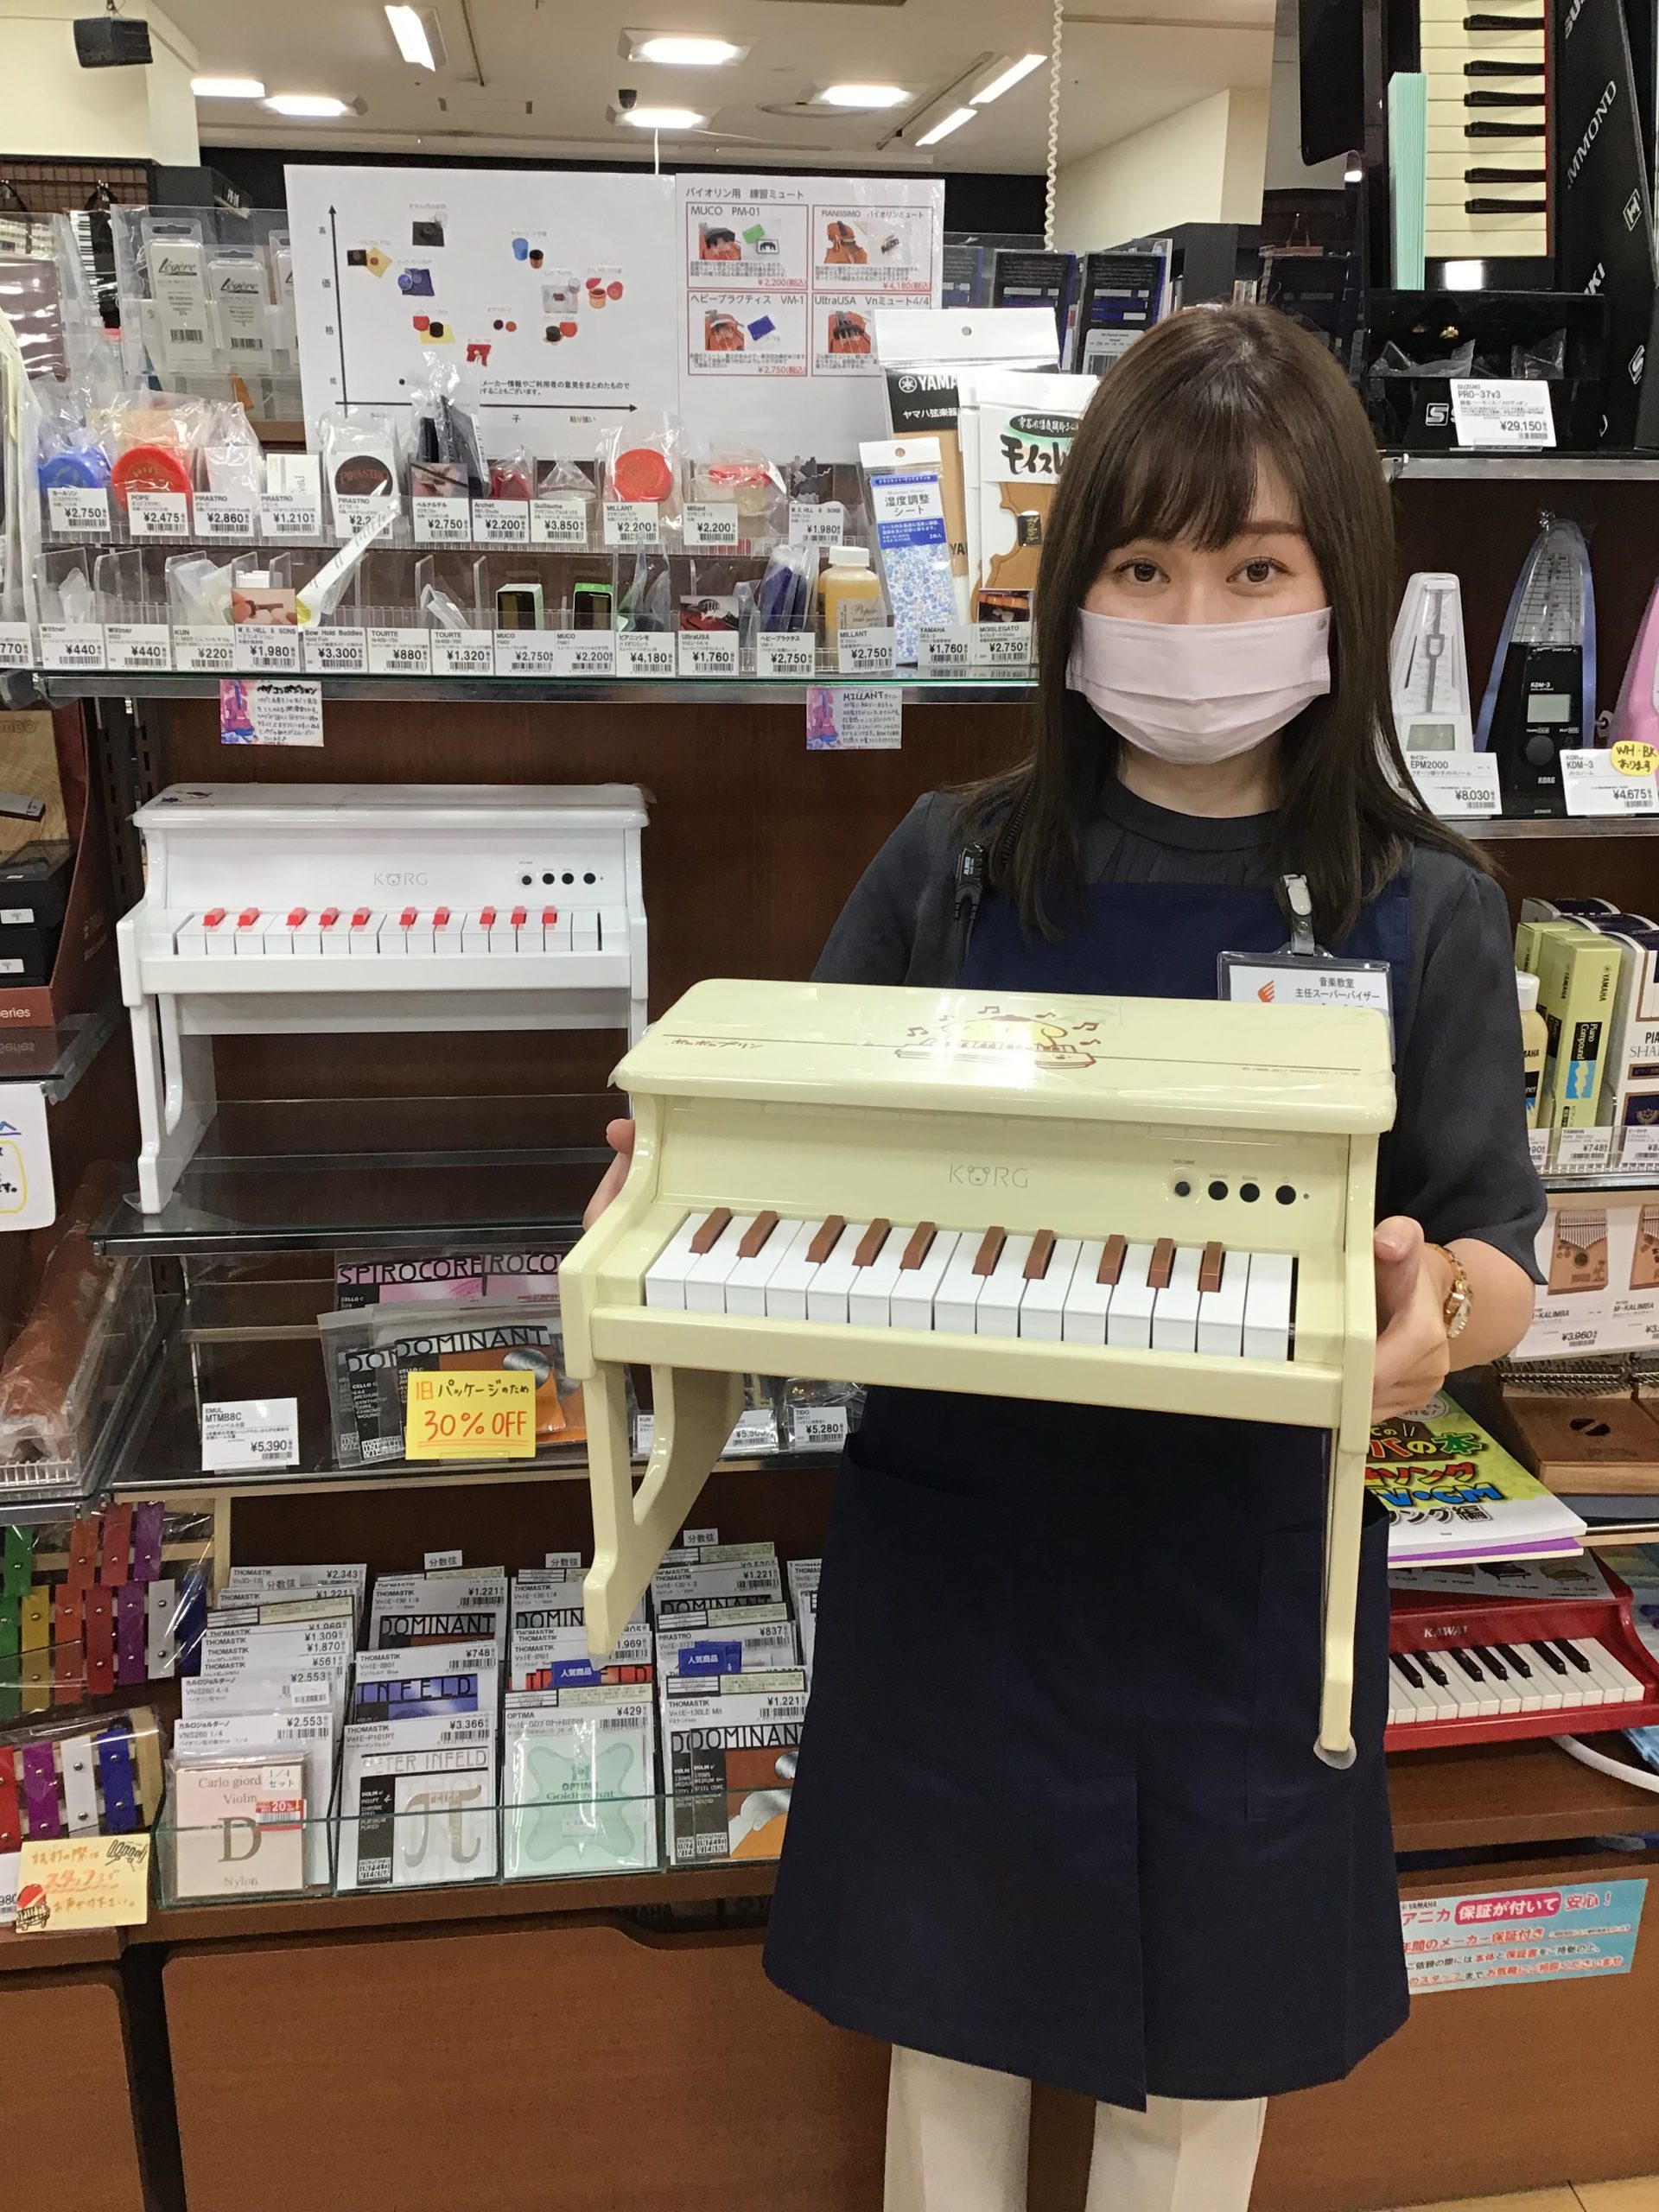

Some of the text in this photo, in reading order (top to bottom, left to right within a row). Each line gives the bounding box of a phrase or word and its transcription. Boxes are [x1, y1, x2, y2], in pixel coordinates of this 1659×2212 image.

[1567, 79, 1618, 189] MMOND
[686, 188, 804, 199] バイオリン用 練習ミュート
[690, 206, 760, 216] MUCO PM-01
[691, 294, 804, 304] ヘビープラクティス VM-1
[814, 296, 856, 305] UltraUSA
[894, 505, 925, 517] シート
[66, 645, 96, 655] ¥440
[131, 645, 161, 657] ¥440
[198, 648, 227, 658] ¥220
[393, 650, 422, 659] ¥880
[1410, 760, 1449, 769] EPM2000
[1618, 760, 1651, 772] あります
[1319, 976, 1355, 988] 音楽教室
[1599, 973, 1611, 1001] YAMAHA
[1296, 988, 1380, 1001] 主任スーパーバイザー
[1613, 1302, 1655, 1312] M-KALIMBA
[397, 1328, 550, 1357] DOMINANT
[416, 1379, 530, 1401] 旧パッケージのため
[206, 1412, 242, 1423] MTMB8C
[424, 1410, 528, 1441] 30% OFF
[688, 1534, 715, 1543] 分数弦
[429, 1556, 458, 1567] 分数弦
[551, 1558, 579, 1567] 分数弦
[266, 1579, 296, 1589] 分数弦
[380, 1614, 496, 1636] DOMINANT
[760, 1626, 783, 1637] ¥837
[1424, 1625, 1468, 1638] KAWAI
[207, 1647, 249, 1656] THOMASTIK
[467, 1649, 490, 1657] ¥748
[688, 1654, 719, 1664] 人気商品
[561, 1668, 593, 1677] 人気商品
[617, 1706, 642, 1716] ¥429
[346, 1725, 389, 1733] THOMASTIK
[426, 1750, 486, 1770] INFELD
[199, 1777, 229, 1789] Carlo
[223, 1794, 257, 1804] Violin
[218, 1816, 262, 1862] D
[224, 1877, 258, 1887] Nylon
[1408, 1901, 1437, 1910] YAMAHA
[1459, 1897, 1559, 1920] 保証が付いて
